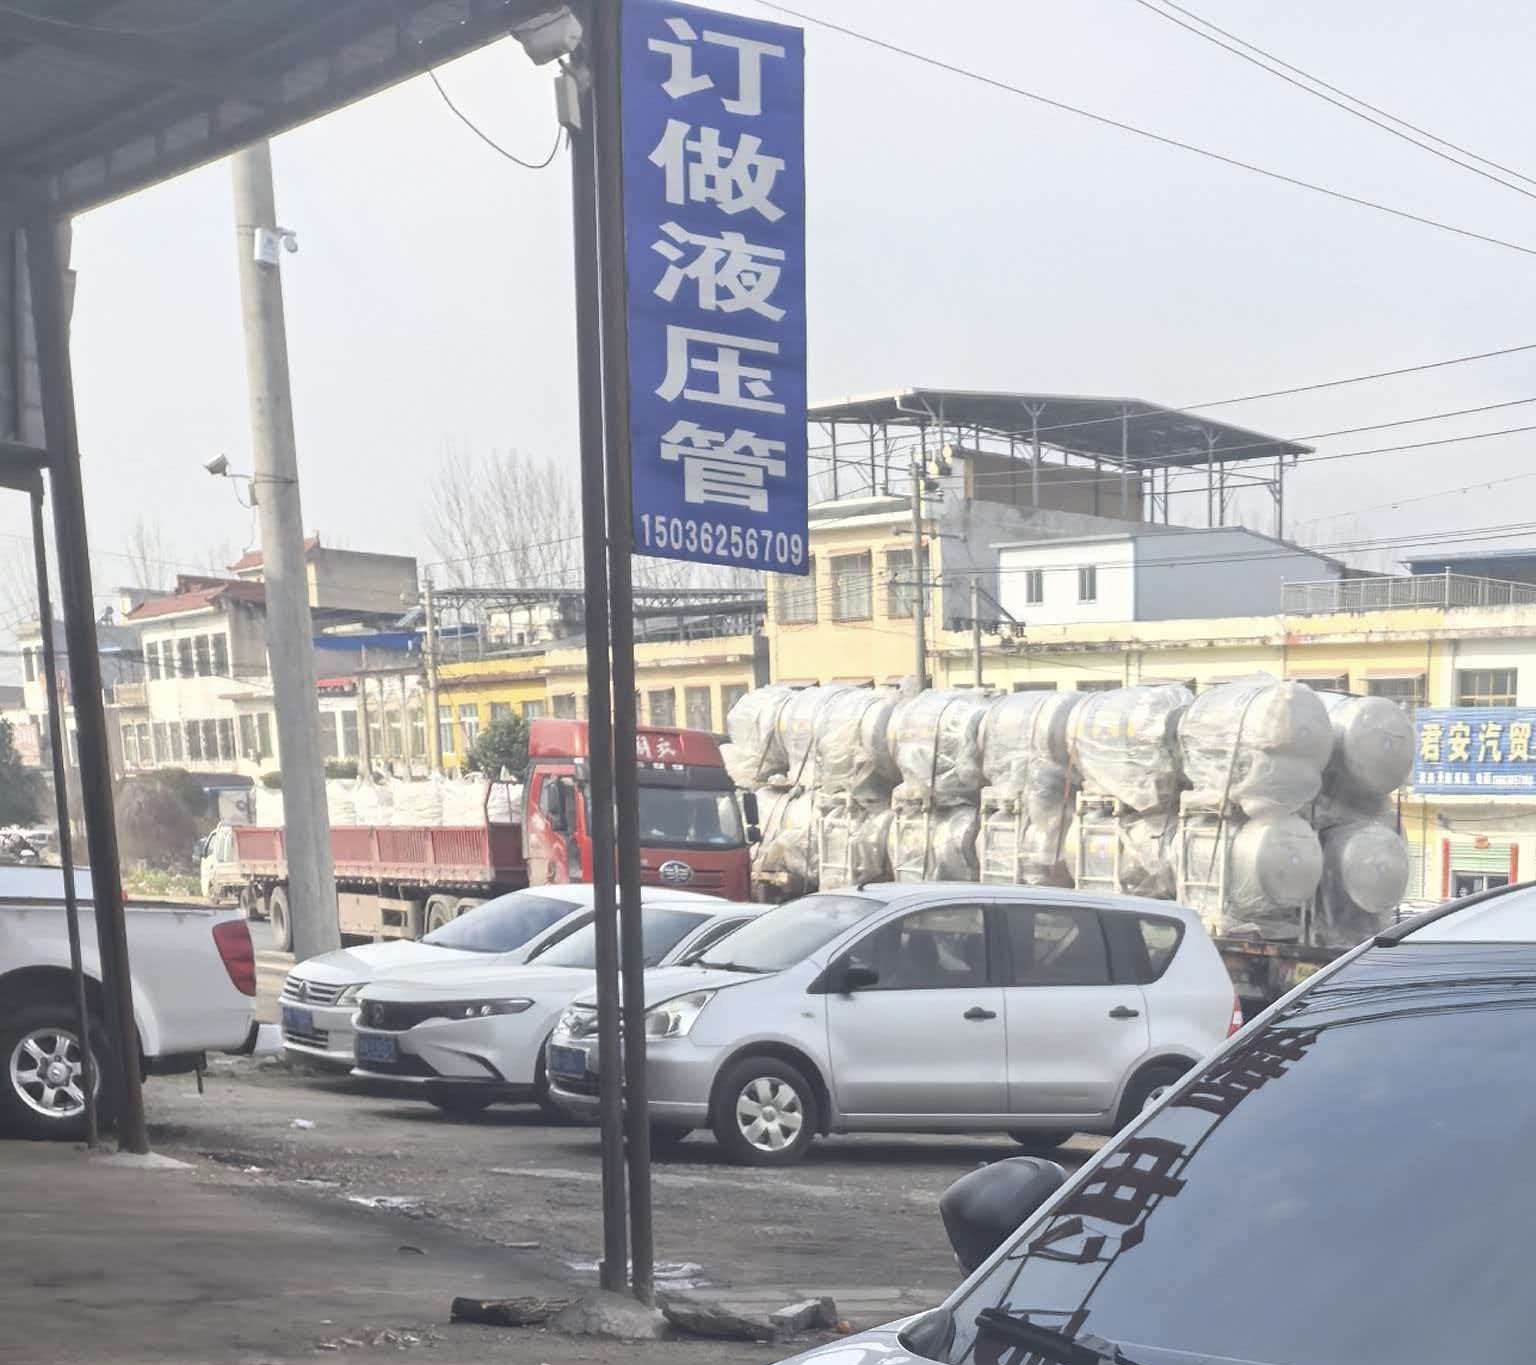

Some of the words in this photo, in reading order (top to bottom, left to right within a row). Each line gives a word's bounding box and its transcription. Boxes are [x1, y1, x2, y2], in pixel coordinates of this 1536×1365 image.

[647, 17, 787, 513] 订做液压管
[641, 513, 803, 566] 15036256709
[1420, 720, 1531, 762] 君安汽贸
